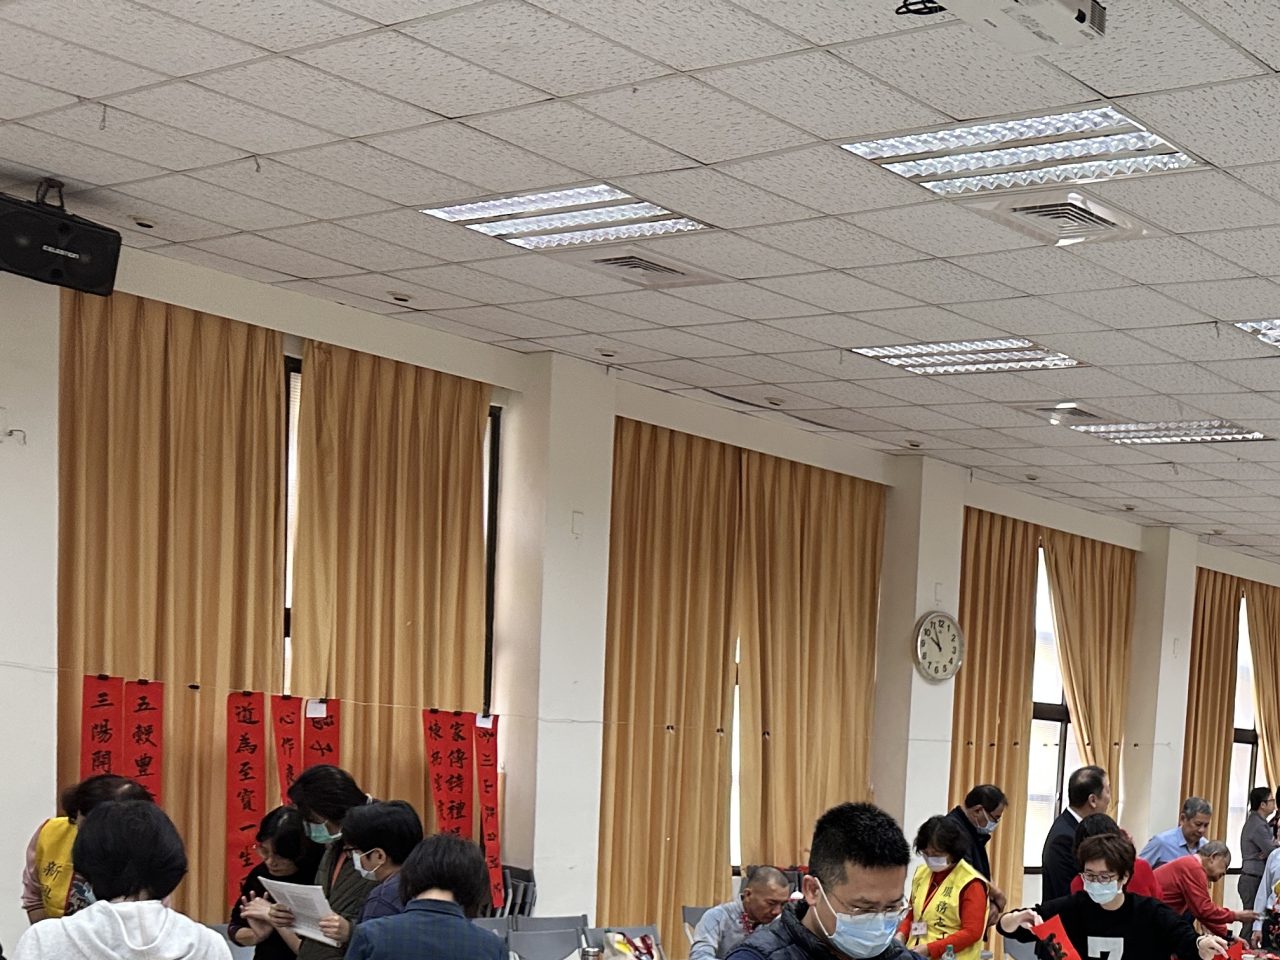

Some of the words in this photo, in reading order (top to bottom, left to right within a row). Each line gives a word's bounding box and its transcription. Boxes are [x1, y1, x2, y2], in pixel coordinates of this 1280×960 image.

[234, 701, 260, 893] 道為至寶一生
